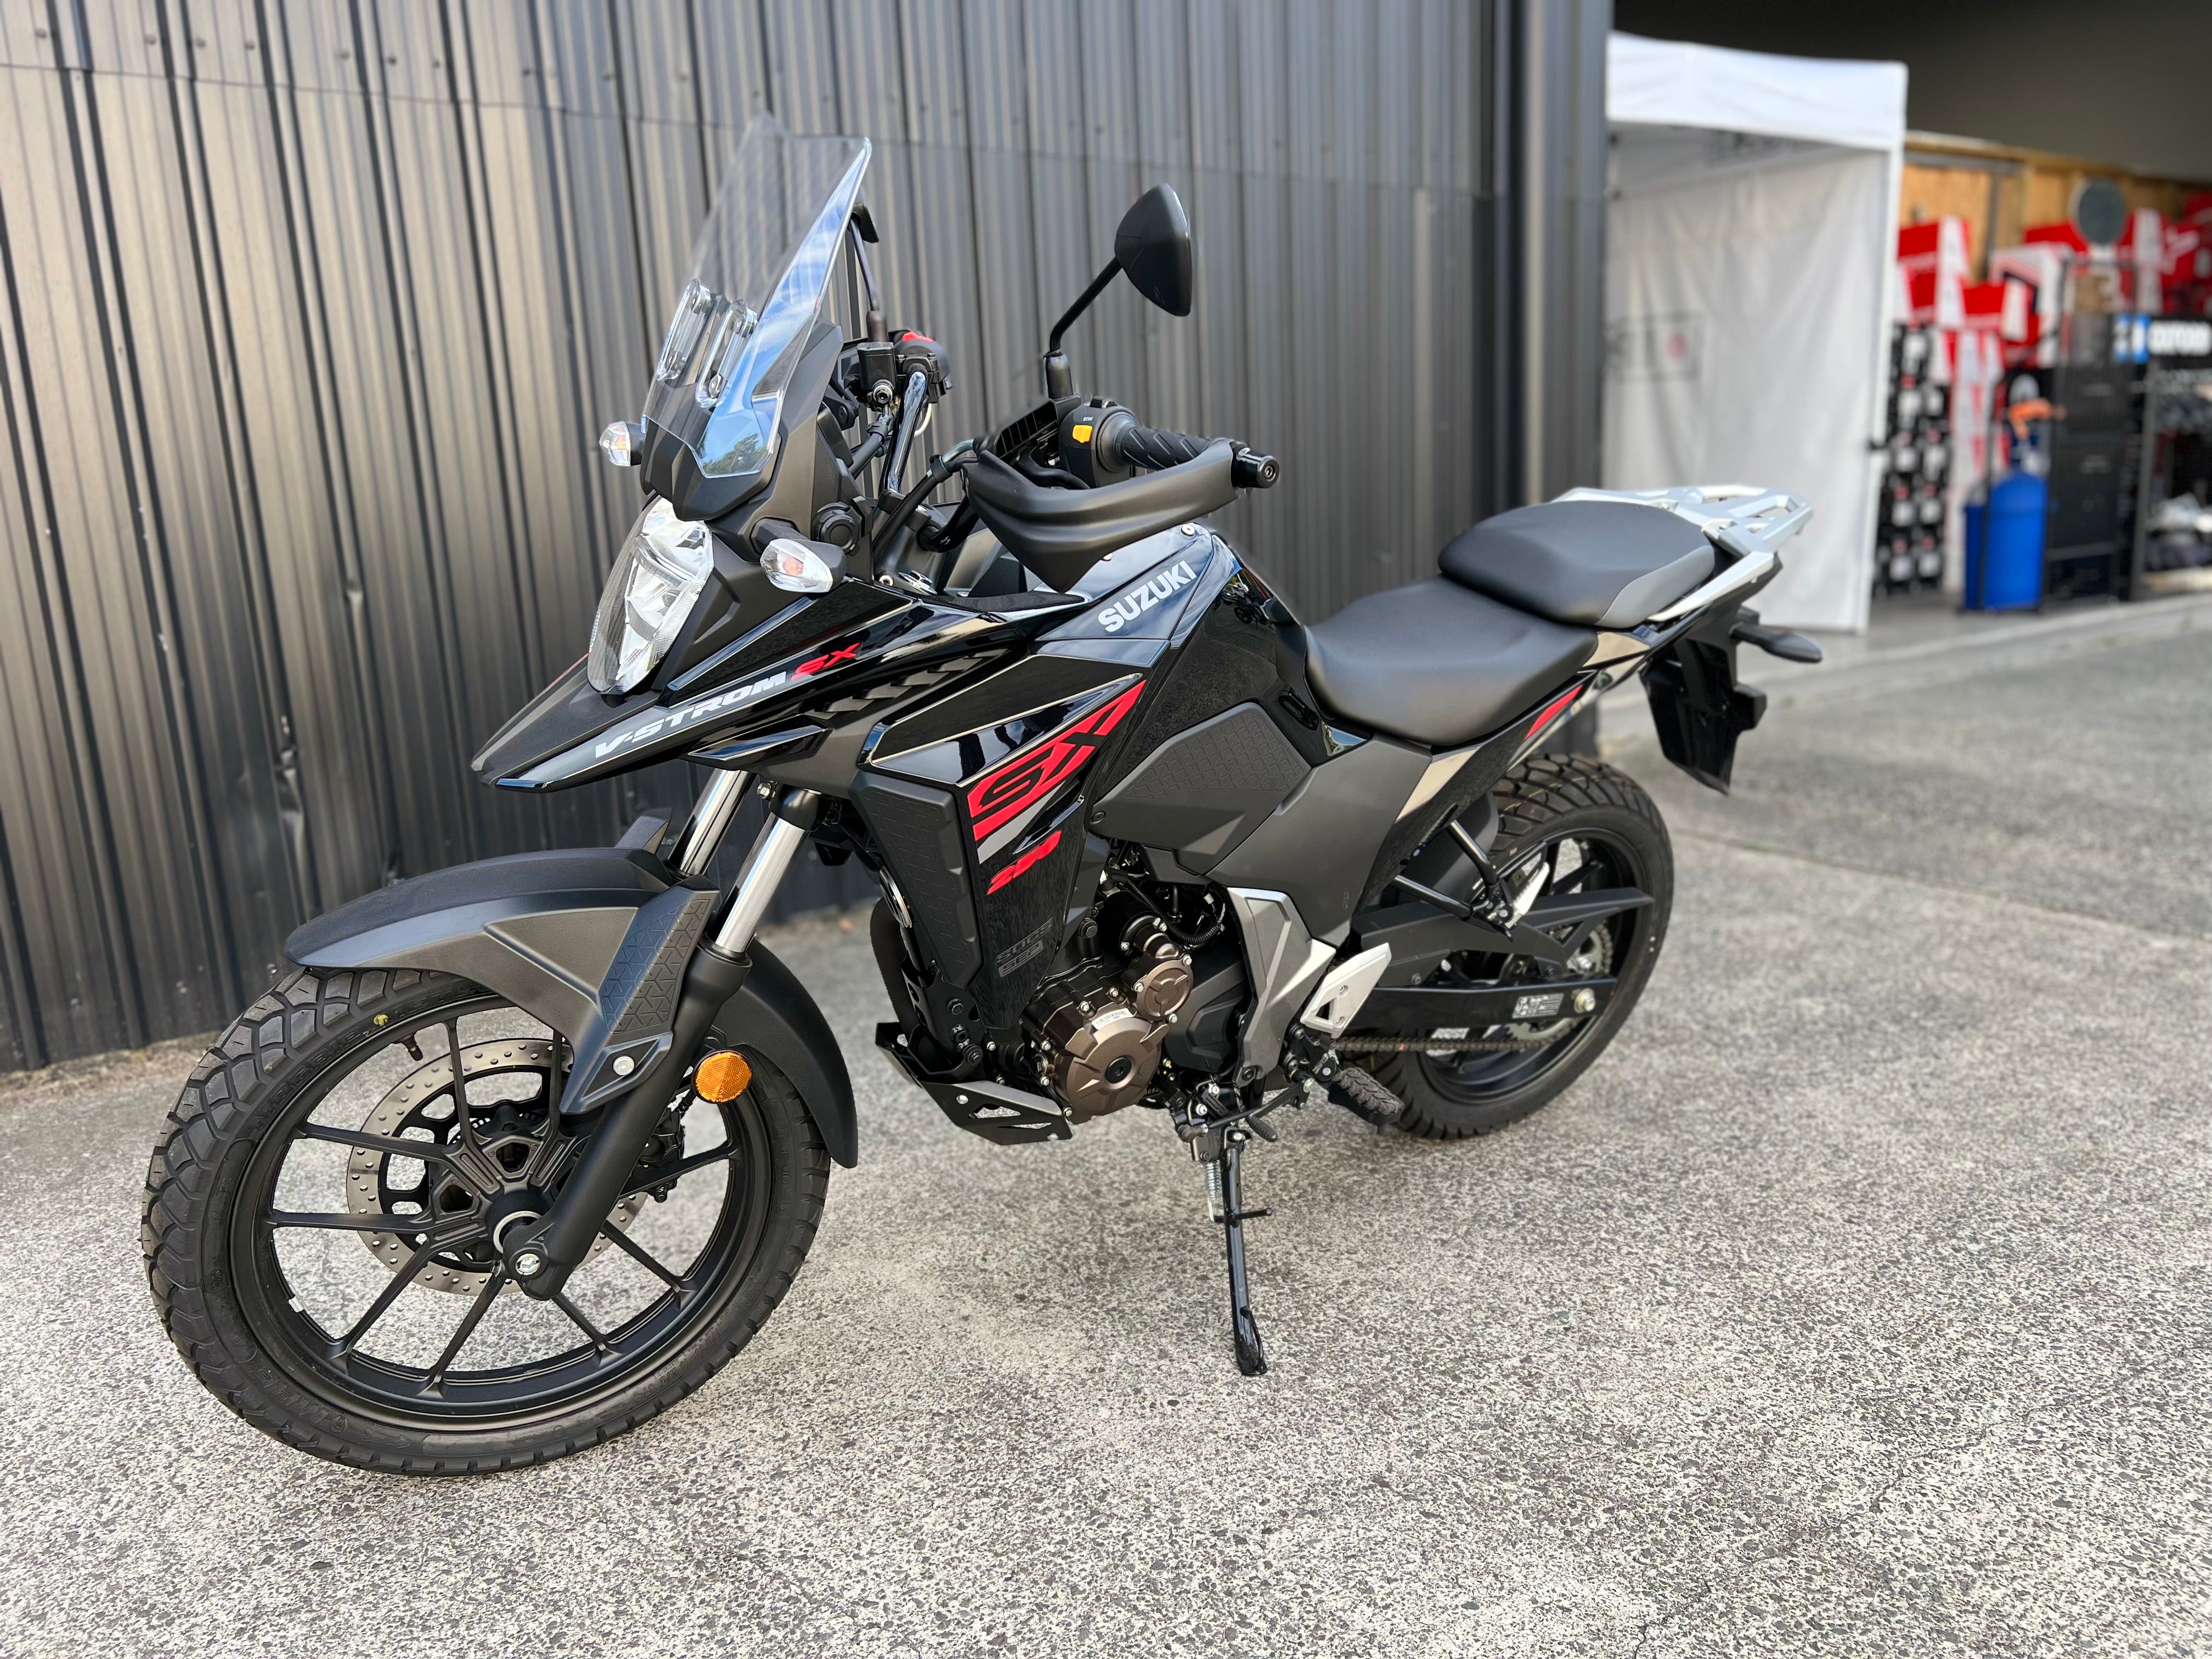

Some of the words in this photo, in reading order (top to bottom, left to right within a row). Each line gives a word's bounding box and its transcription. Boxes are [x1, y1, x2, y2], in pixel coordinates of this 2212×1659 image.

[1098, 560, 1197, 633] SUZUKI
[595, 671, 786, 758] V-STROM
[791, 642, 861, 681] SX
[967, 680, 1147, 842] SX
